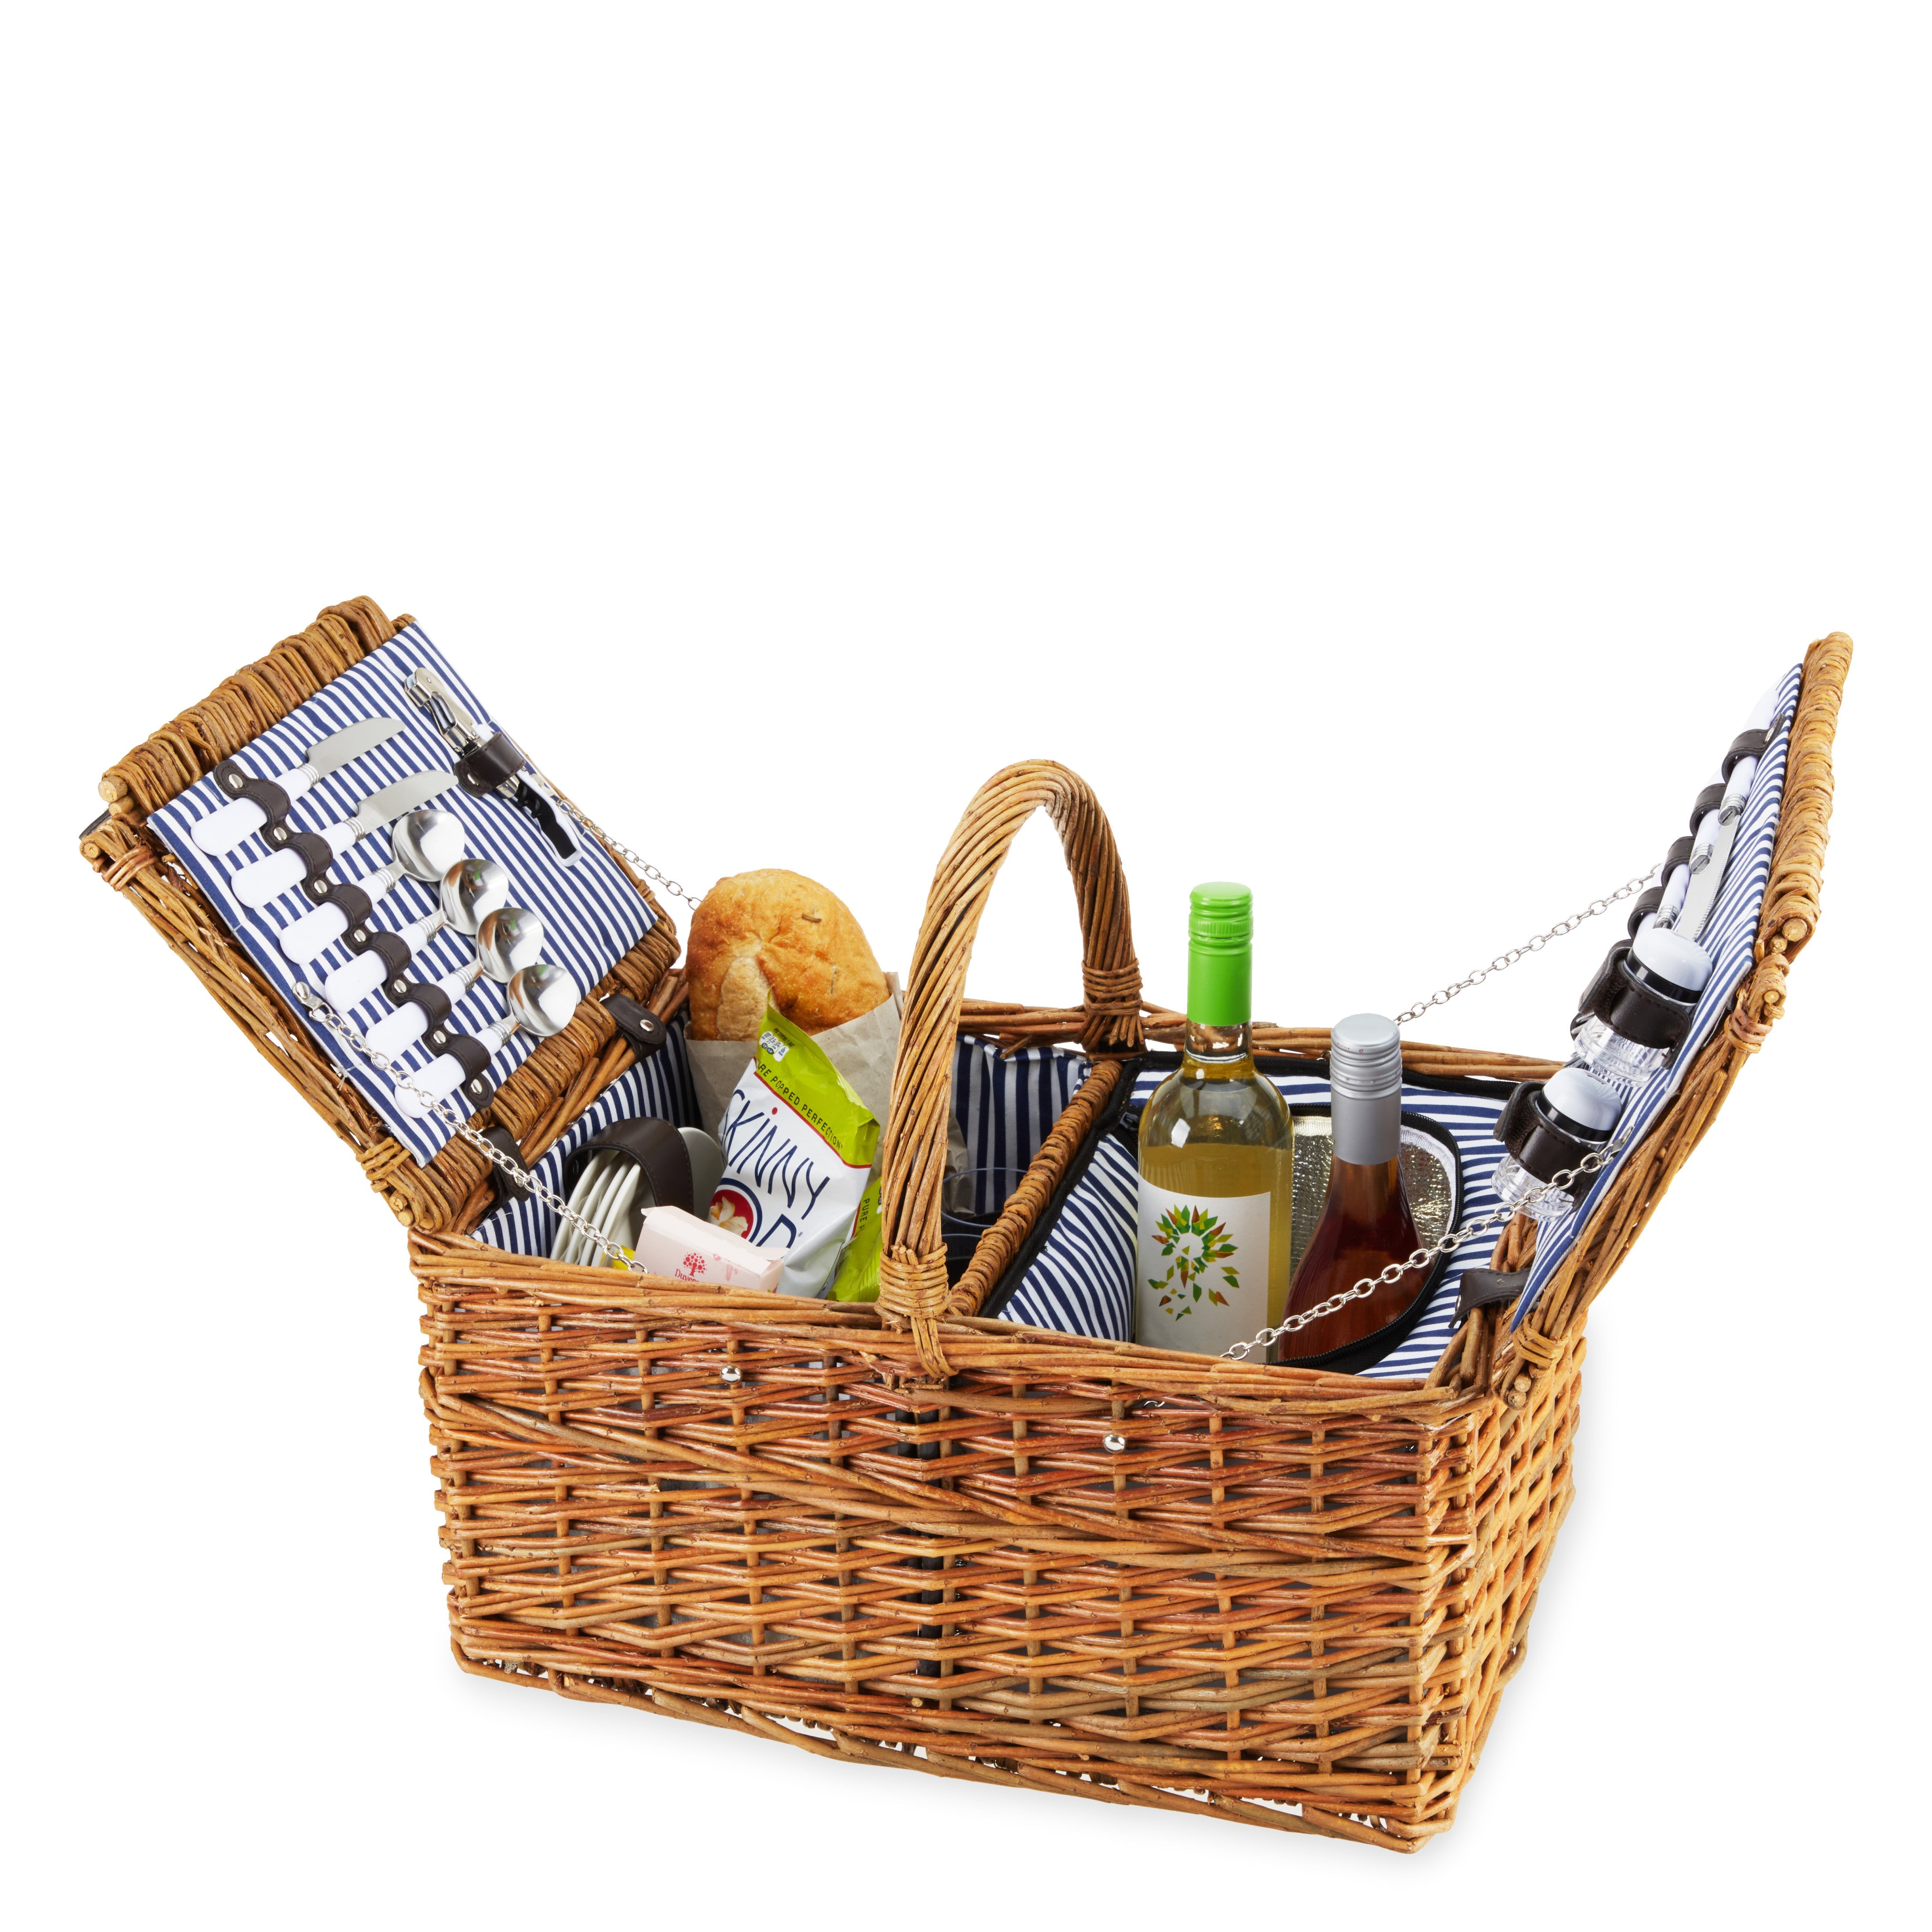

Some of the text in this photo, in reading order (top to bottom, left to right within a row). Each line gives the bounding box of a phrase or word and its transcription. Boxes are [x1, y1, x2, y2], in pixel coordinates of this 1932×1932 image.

[770, 1076, 800, 1105] POPPED
[802, 1104, 841, 1150] PERFECTION
[859, 1198, 870, 1222] PURE
